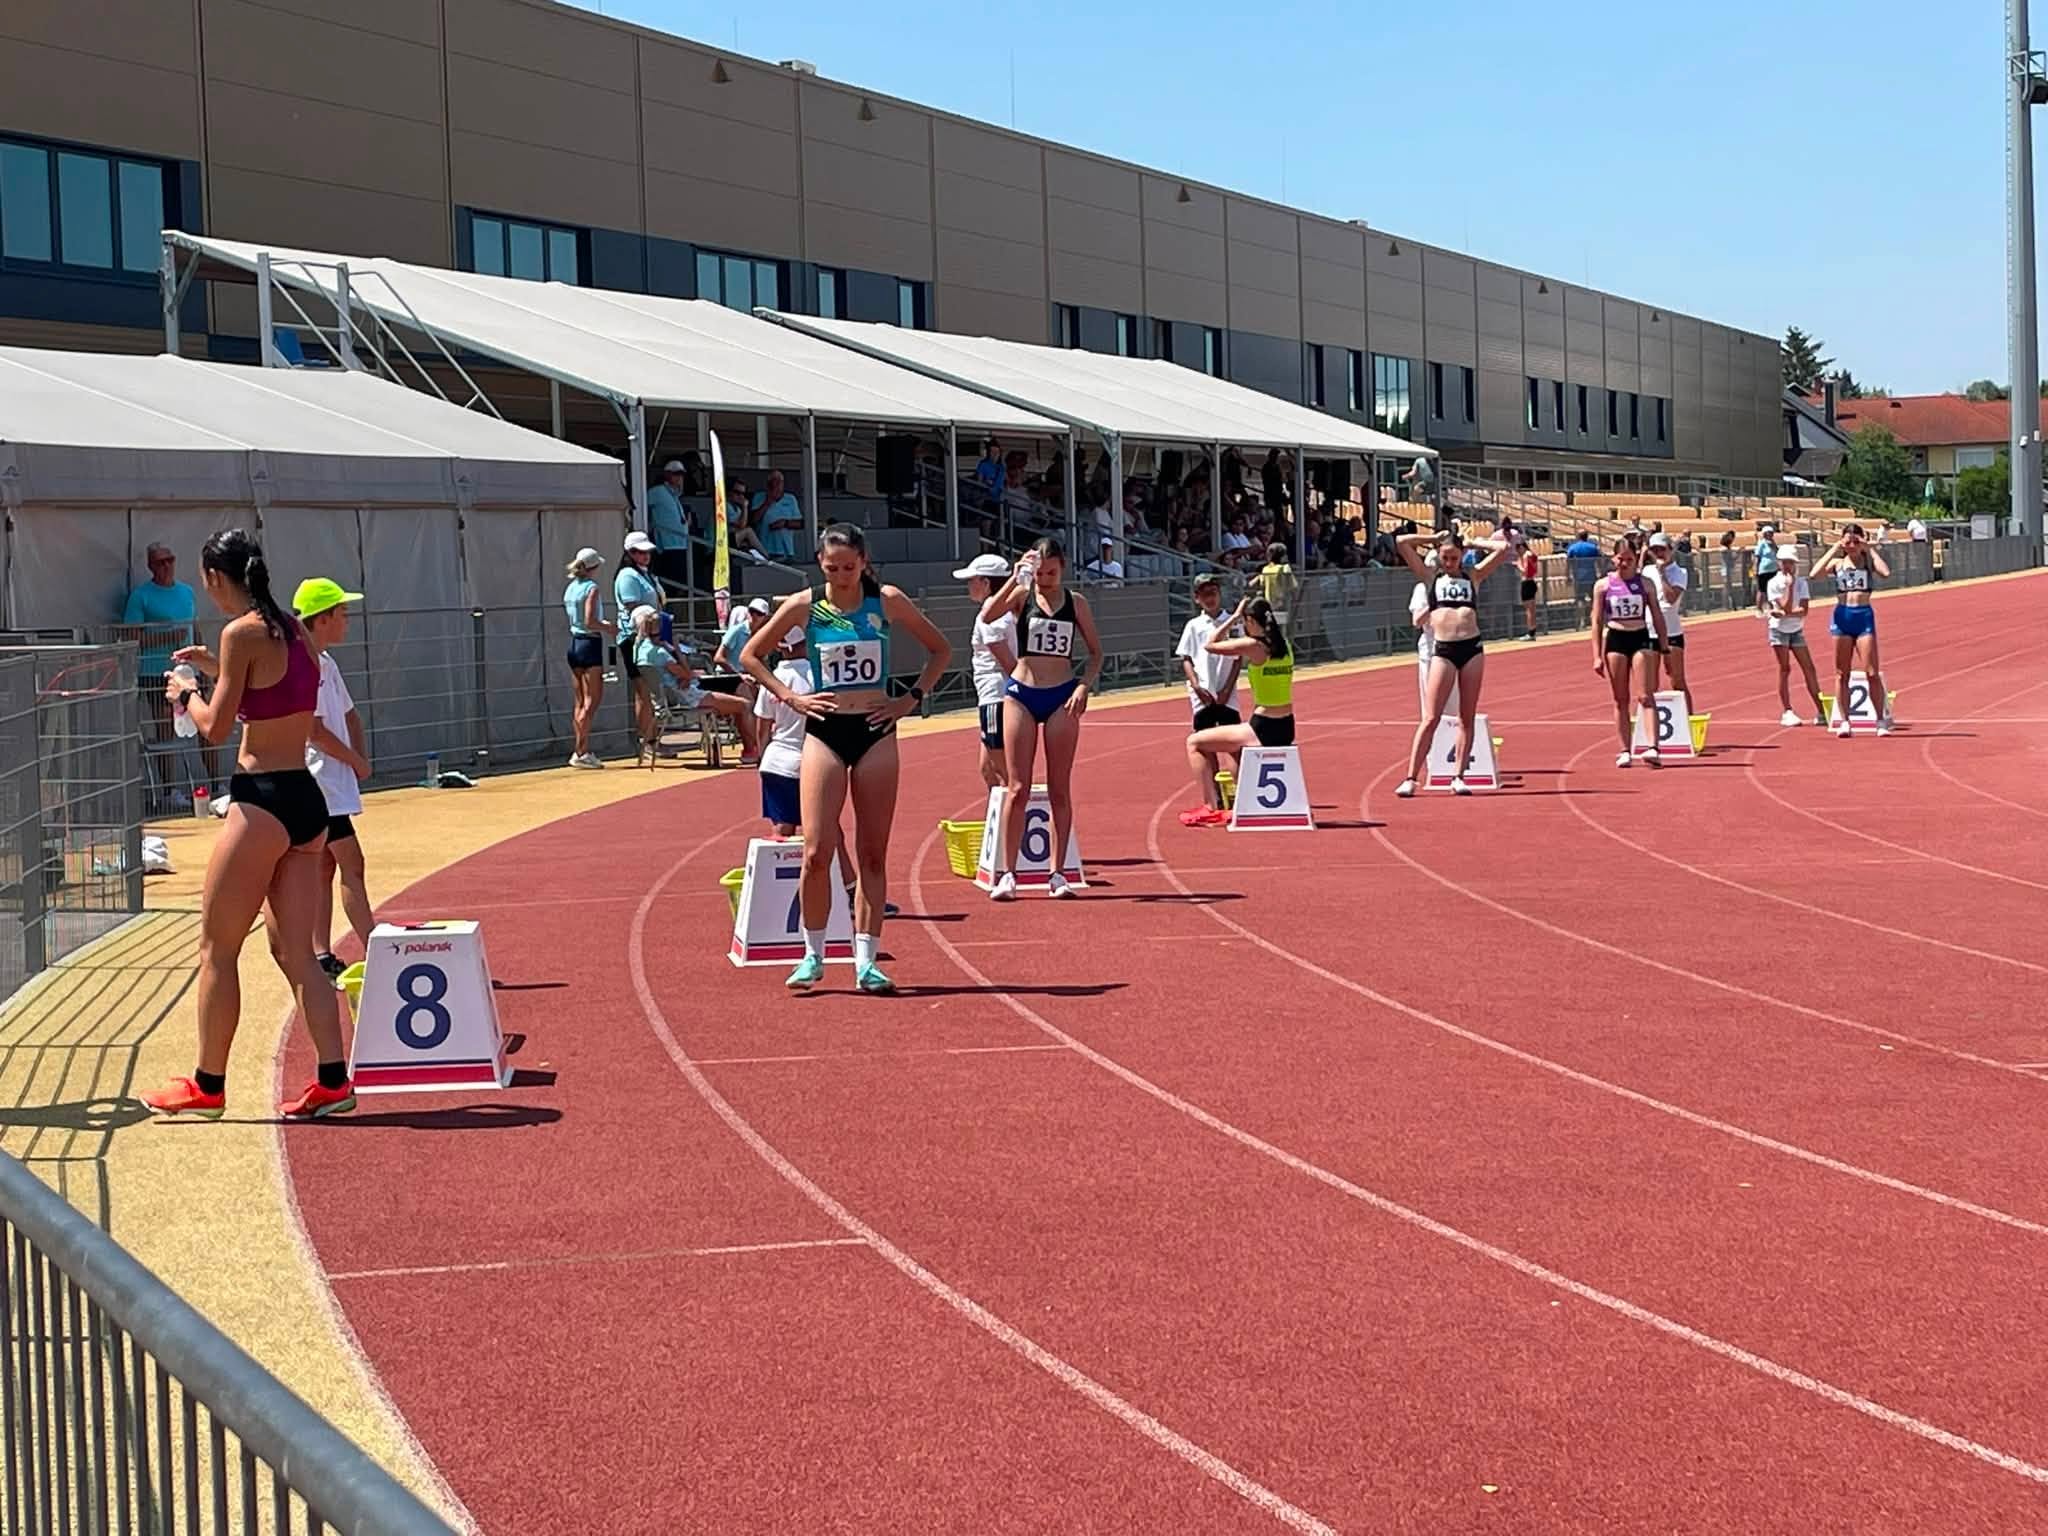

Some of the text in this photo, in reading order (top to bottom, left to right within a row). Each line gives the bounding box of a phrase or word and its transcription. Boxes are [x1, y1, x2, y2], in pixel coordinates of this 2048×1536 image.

[1442, 586, 1469, 600] 104
[1615, 604, 1640, 617] 132
[1034, 633, 1069, 653] 133
[828, 659, 876, 682] 150
[1849, 685, 1868, 716] 2
[1655, 706, 1674, 741] 3
[1257, 763, 1287, 808] 5
[1021, 808, 1051, 862] 6
[404, 942, 452, 956] polanik
[395, 963, 451, 1049] 8
